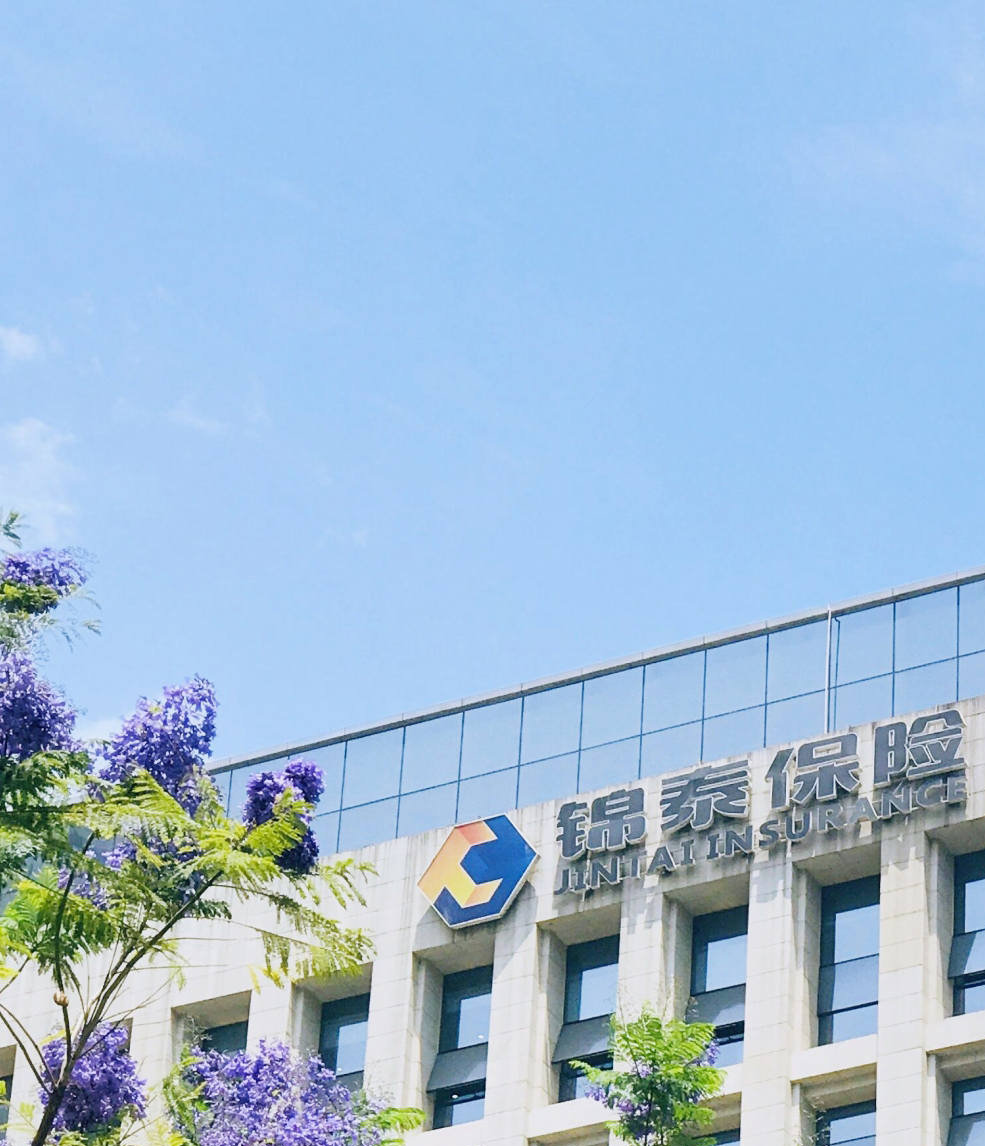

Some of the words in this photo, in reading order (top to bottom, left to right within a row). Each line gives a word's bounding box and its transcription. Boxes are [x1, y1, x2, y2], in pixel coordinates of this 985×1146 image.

[554, 838, 696, 895] JINTAI
[706, 769, 968, 861] INSURANCE
[556, 709, 967, 860] 锦泰保险
